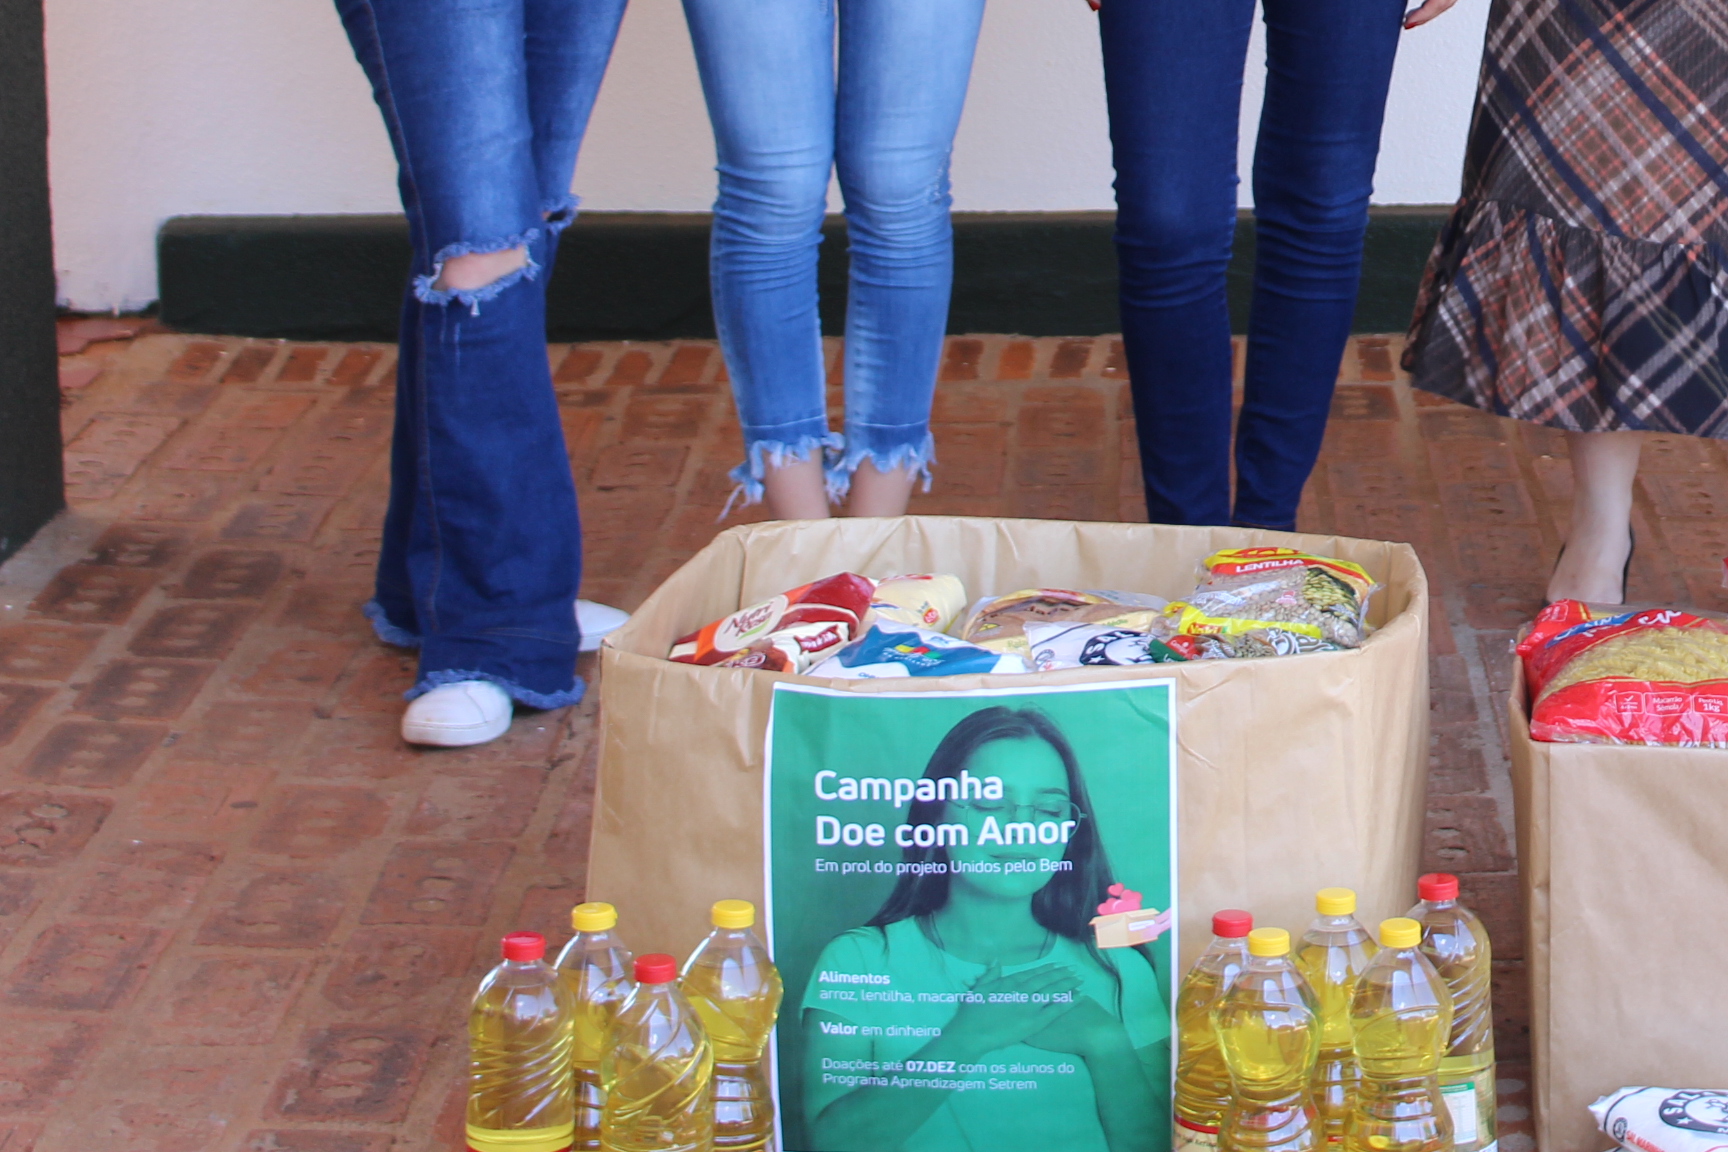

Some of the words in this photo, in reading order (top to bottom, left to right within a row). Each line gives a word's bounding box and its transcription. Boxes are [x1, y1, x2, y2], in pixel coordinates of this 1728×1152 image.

[1235, 559, 1304, 574] LENTILHA
[814, 769, 1003, 808] Campanha
[815, 815, 886, 846] Doe
[894, 823, 969, 847] com
[976, 815, 1076, 846] Amor
[815, 858, 839, 872] Em
[842, 860, 871, 875] prol
[874, 860, 893, 873] do
[896, 861, 947, 877] projeto
[951, 860, 1001, 873] Unidos
[1004, 858, 1036, 875] pelo
[1040, 858, 1073, 872] Bem
[819, 970, 891, 985] Alimentos
[820, 989, 858, 1001] arroz,
[861, 989, 915, 1003] lentilha,
[918, 991, 986, 1004] macarrão,
[988, 991, 1029, 1003] azeite
[1031, 993, 1050, 1003] ou
[1052, 990, 1074, 1003] sal
[820, 1021, 858, 1035] Valor
[861, 1026, 883, 1036] em
[886, 1025, 942, 1037] dinheiro
[822, 1057, 879, 1071] Doações
[882, 1059, 904, 1071] até
[905, 1060, 956, 1073] 07.DEZ
[959, 1063, 988, 1074] com
[990, 1063, 1007, 1074] os
[1009, 1062, 1055, 1074] alunos
[1057, 1062, 1075, 1074] do
[822, 1073, 889, 1087] Programa
[890, 1075, 986, 1091] Aprendizagem
[988, 1078, 1038, 1089] Setrem
